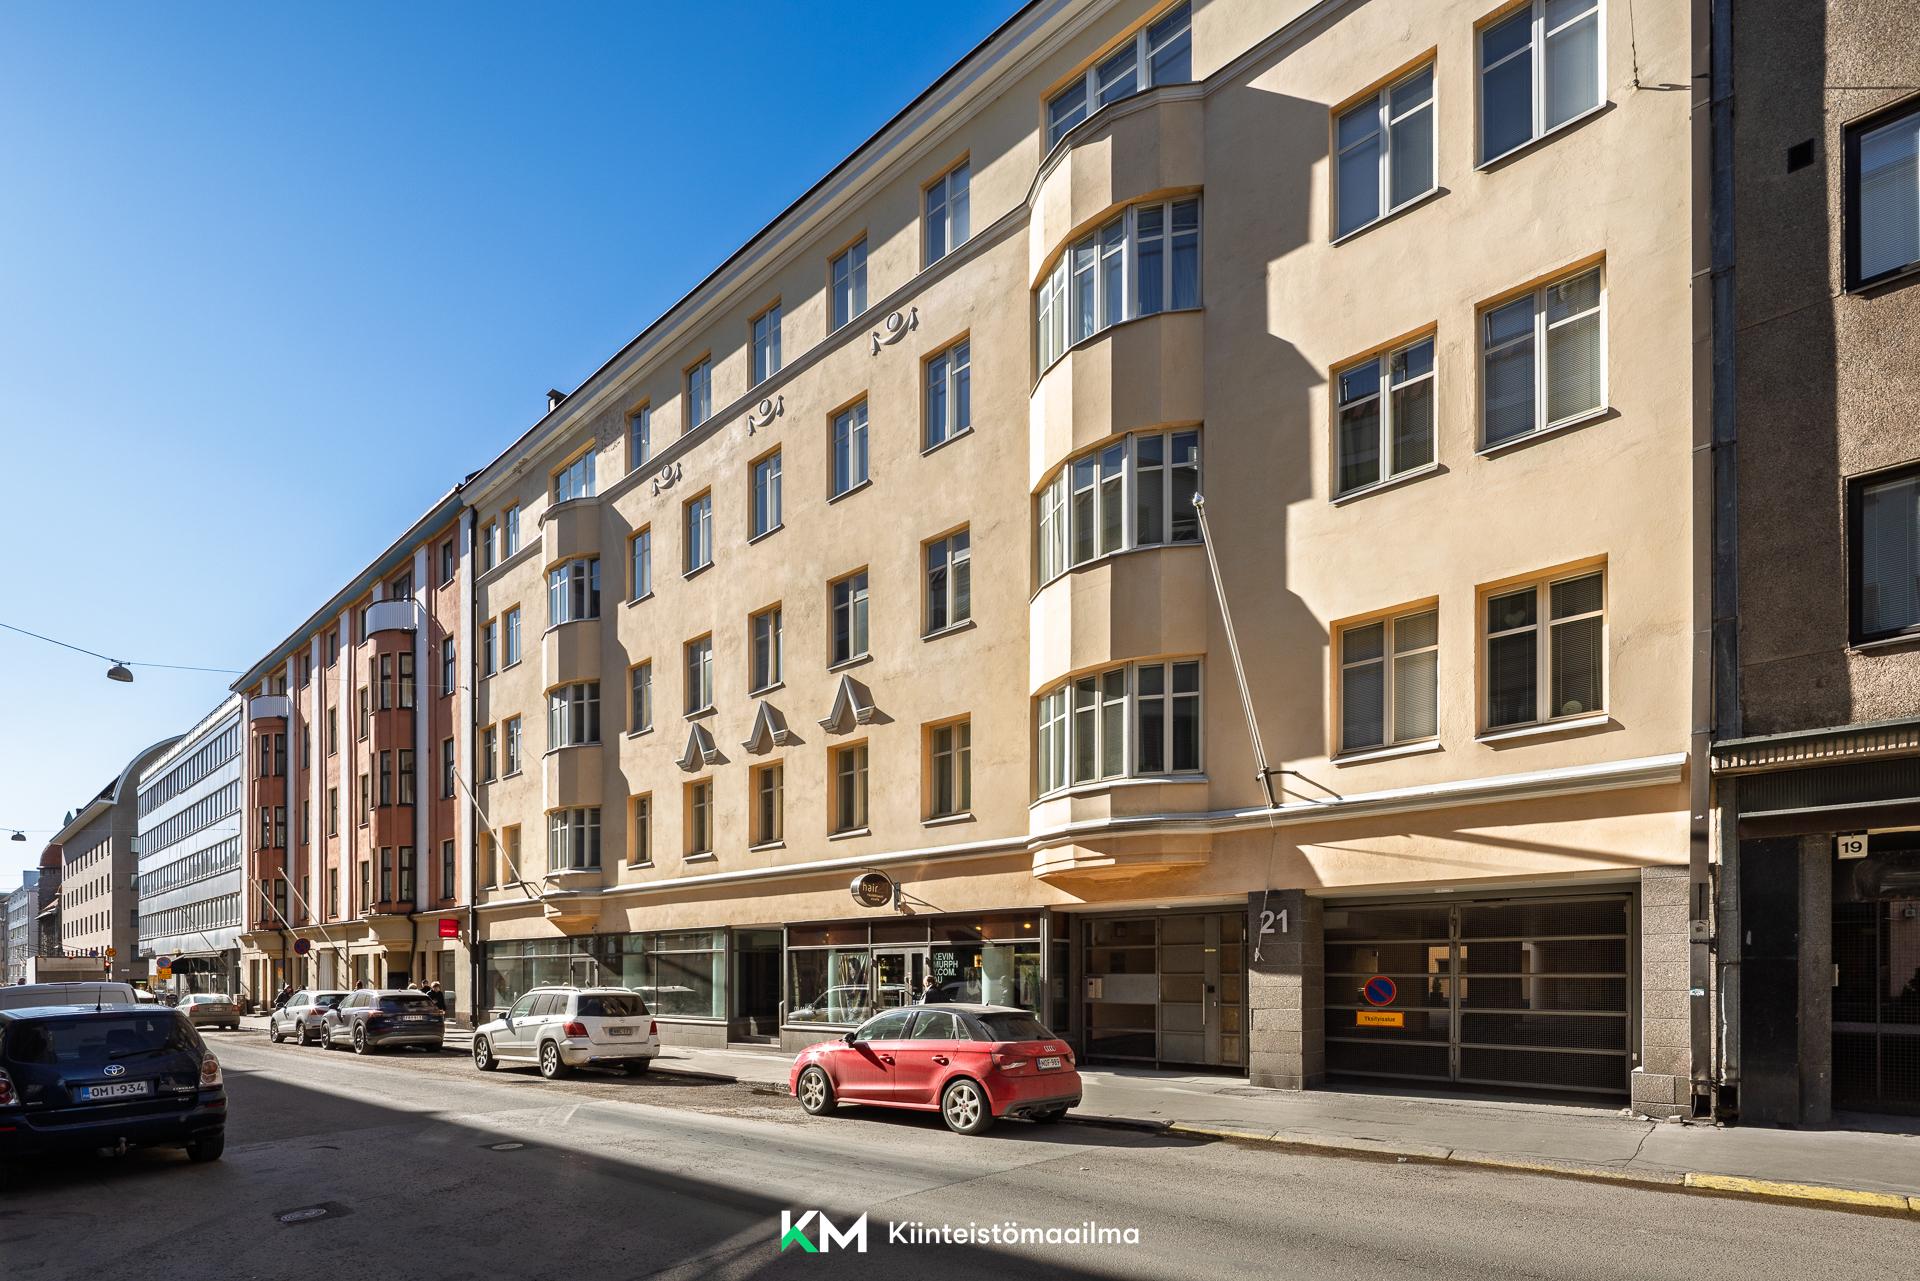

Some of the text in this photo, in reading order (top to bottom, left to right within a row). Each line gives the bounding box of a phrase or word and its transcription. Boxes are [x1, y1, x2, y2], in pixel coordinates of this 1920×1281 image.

[1841, 840, 1863, 854] 19
[862, 881, 878, 893] hair
[1260, 909, 1288, 934] 21
[933, 952, 954, 961] KEVIN
[933, 960, 959, 969] MURPH
[91, 1081, 146, 1097] OMI-934
